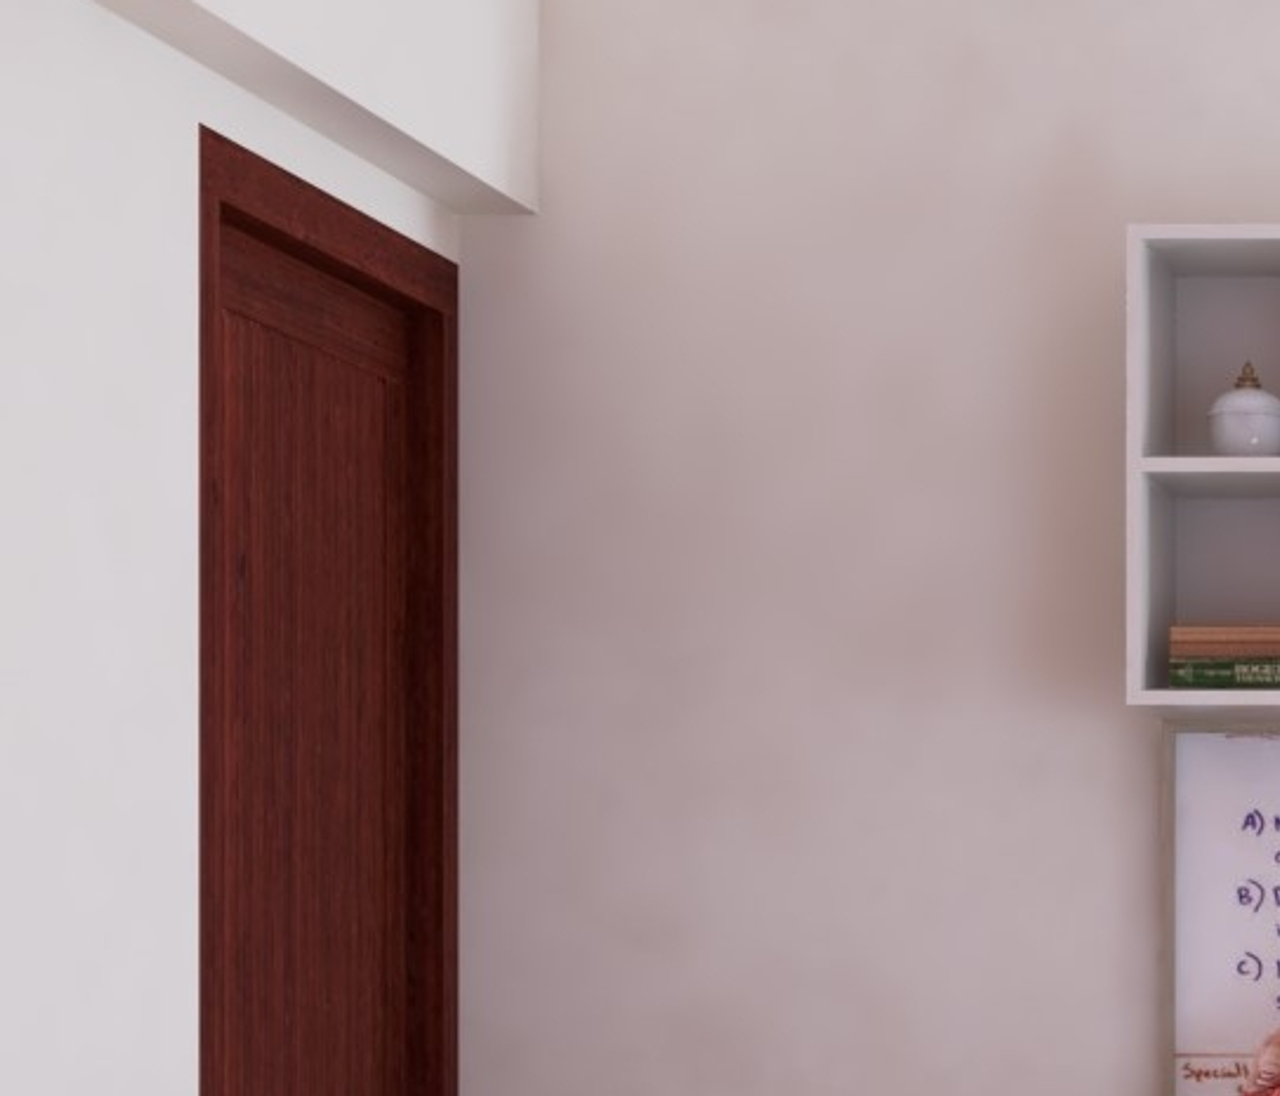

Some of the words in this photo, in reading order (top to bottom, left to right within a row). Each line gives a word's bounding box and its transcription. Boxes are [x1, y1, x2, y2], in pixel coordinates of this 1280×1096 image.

[1241, 809, 1265, 837] A)
[1237, 879, 1265, 912] B)
[1236, 952, 1263, 981] C)
